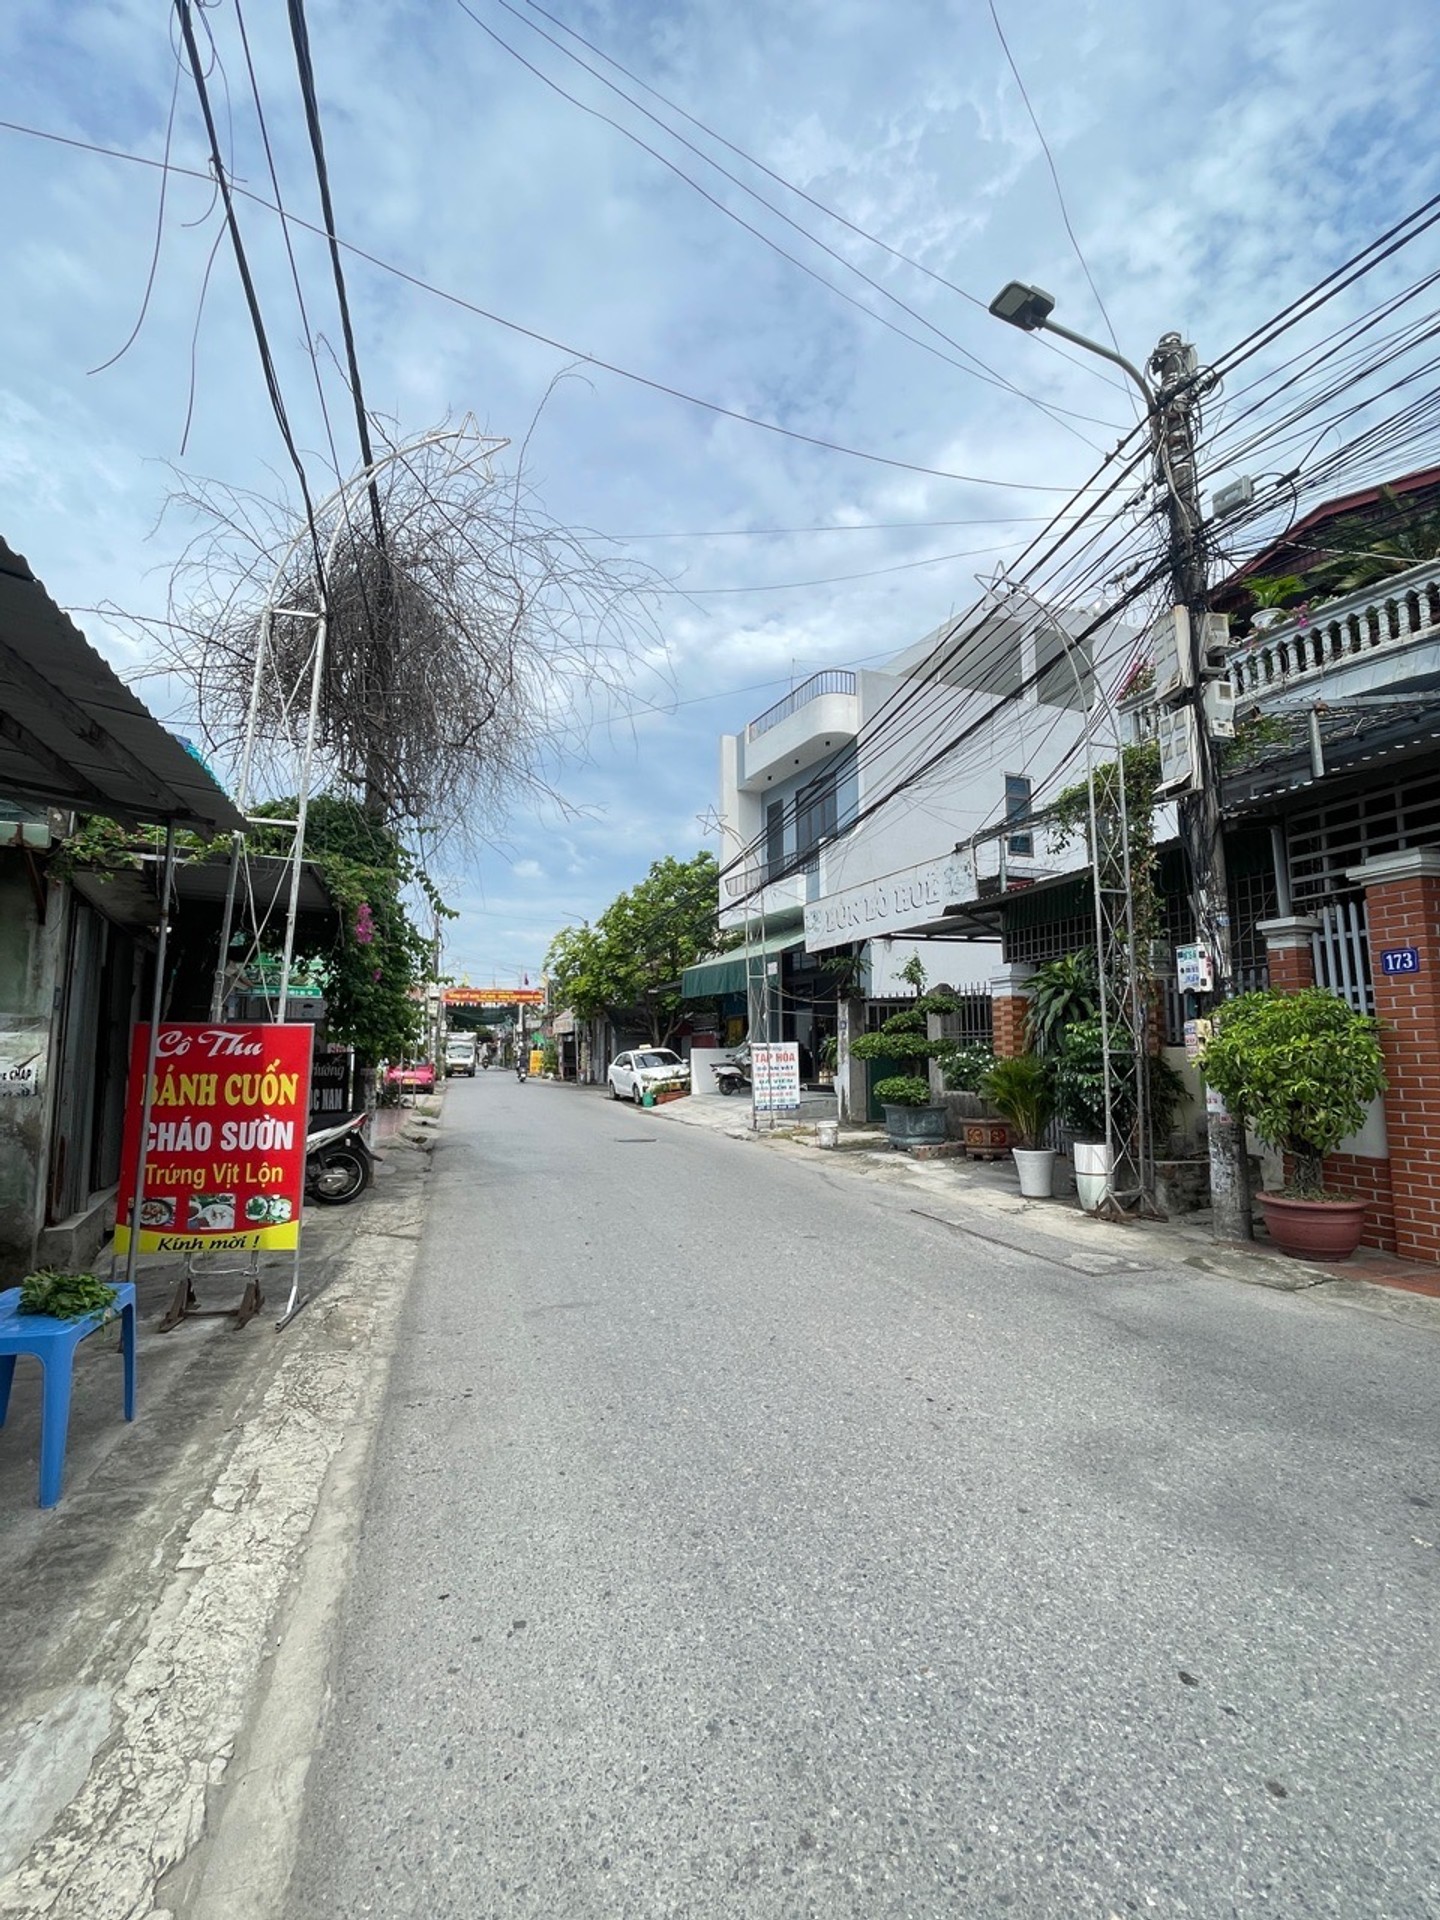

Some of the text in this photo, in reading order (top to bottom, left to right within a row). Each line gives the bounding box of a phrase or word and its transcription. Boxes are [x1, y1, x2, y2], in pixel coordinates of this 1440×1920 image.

[1385, 952, 1413, 970] 173
[156, 1030, 264, 1057] Cô Thu
[224, 1058, 299, 1106] CUỐN
[146, 1114, 294, 1152] CHÁO SƯỜN
[145, 1162, 283, 1189] Trứng Vịt Lộn
[157, 1235, 260, 1251] Kính mời !
